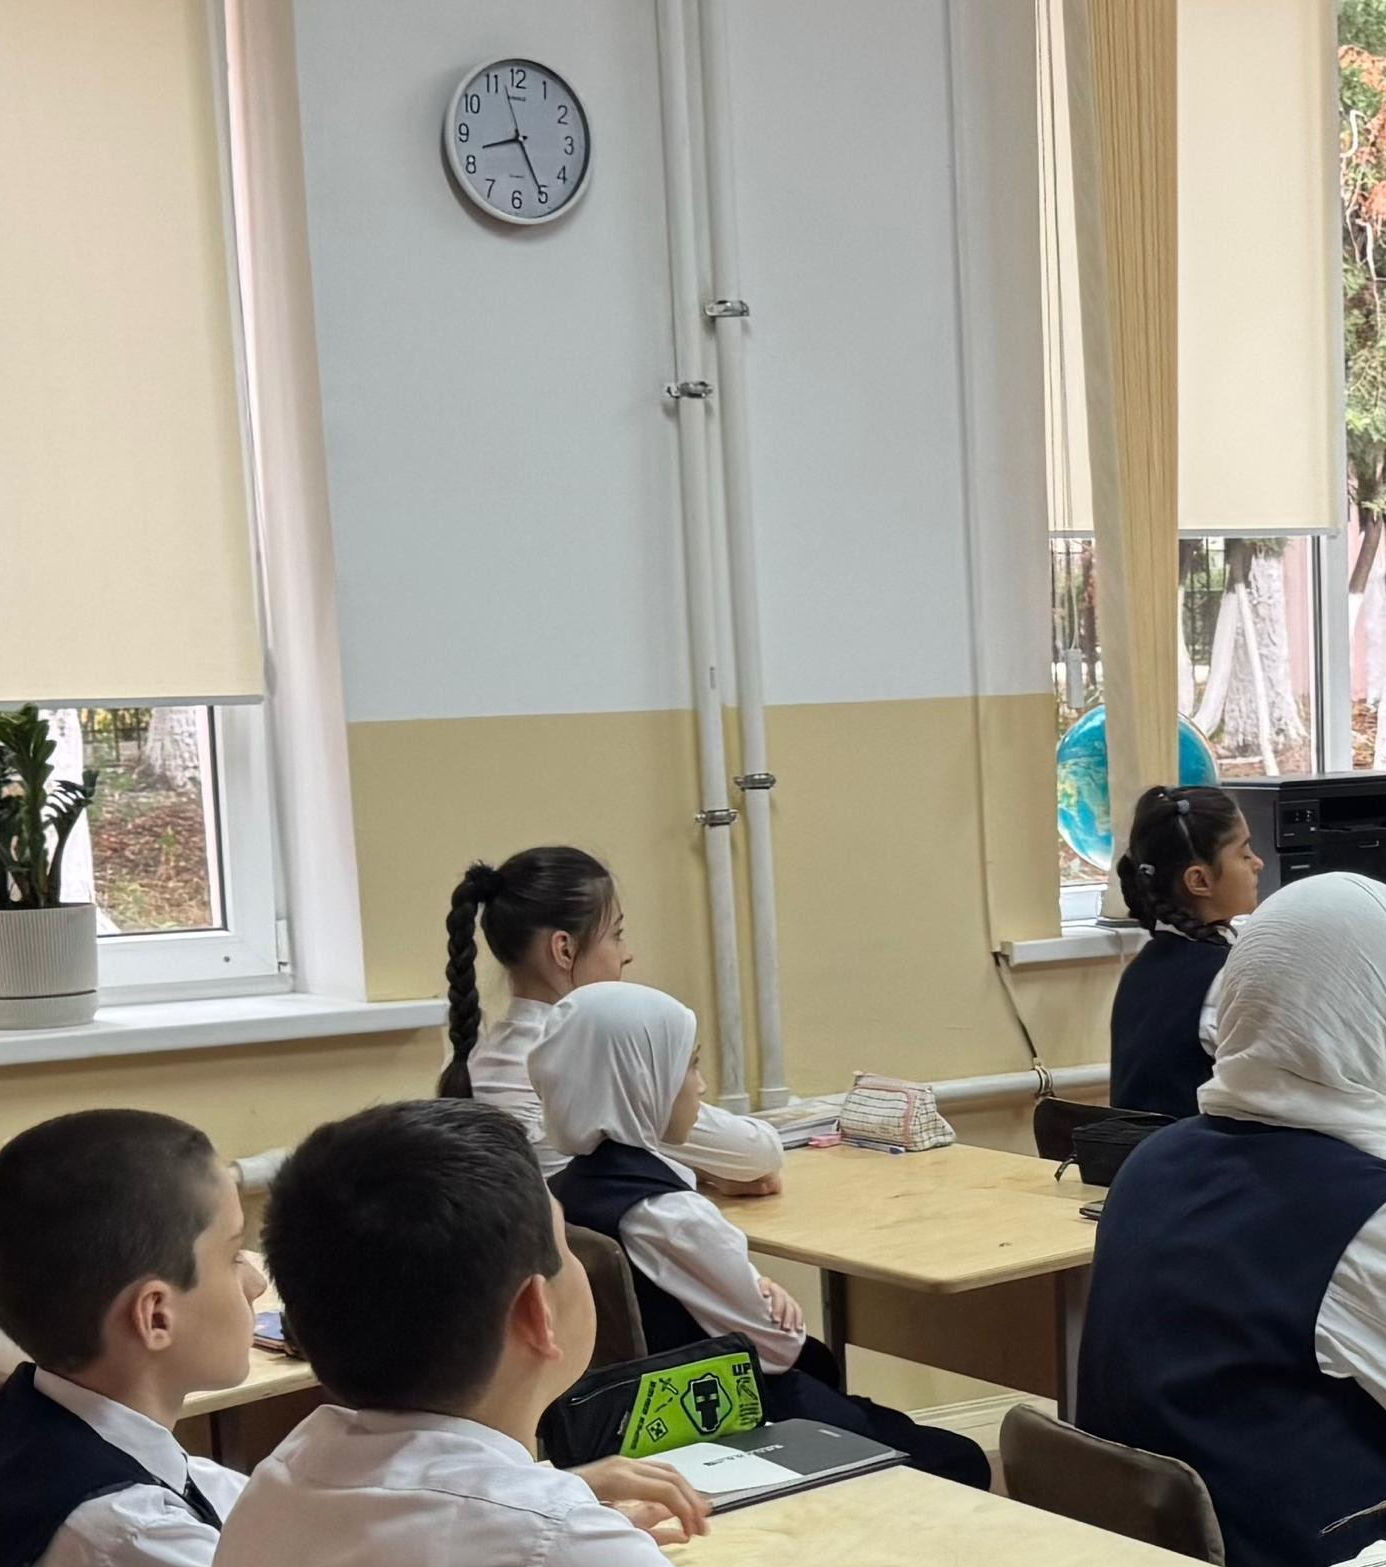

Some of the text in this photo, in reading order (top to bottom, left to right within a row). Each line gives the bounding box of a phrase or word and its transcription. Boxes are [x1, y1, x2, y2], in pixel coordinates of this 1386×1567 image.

[486, 73, 499, 93] 11
[510, 69, 526, 89] 12
[465, 93, 481, 114] 10
[557, 105, 568, 125] 2
[458, 123, 469, 143] 9
[564, 136, 574, 156] 3
[465, 155, 477, 174] 8
[557, 165, 568, 184] 4
[485, 178, 496, 199] 7
[538, 184, 549, 205] 5
[511, 190, 523, 210] 6
